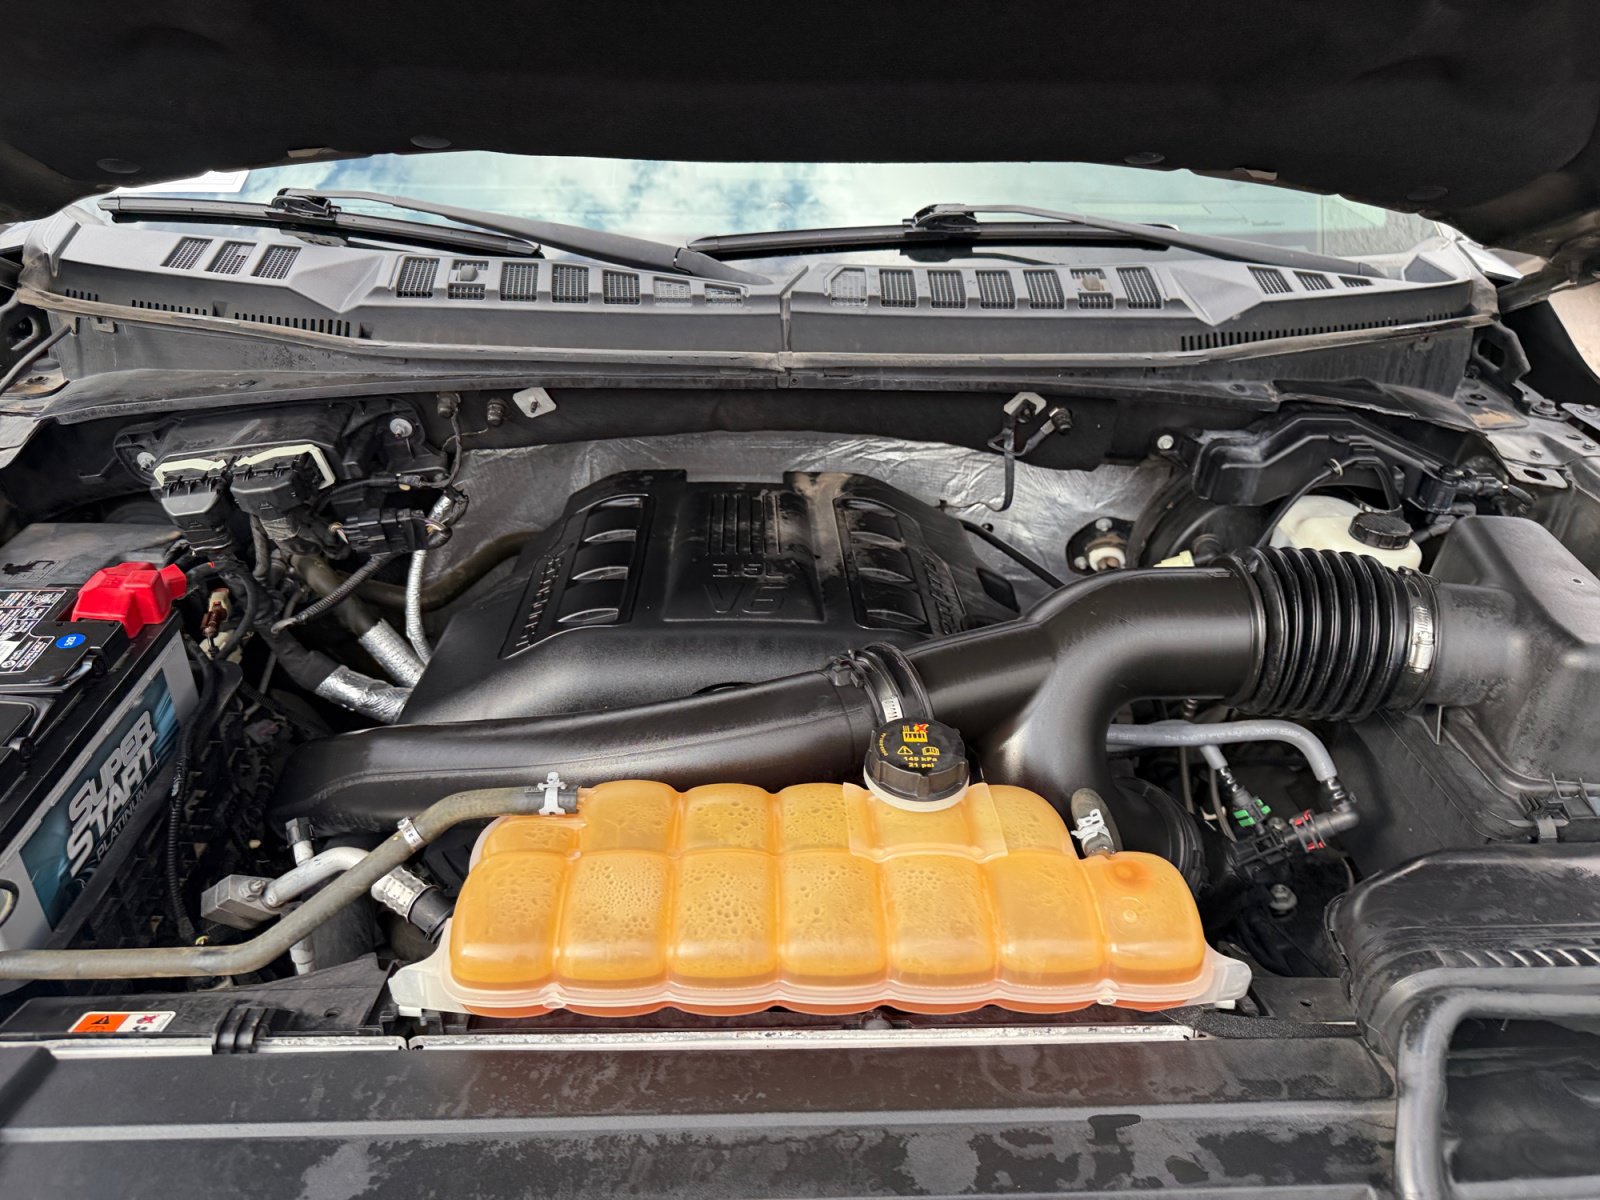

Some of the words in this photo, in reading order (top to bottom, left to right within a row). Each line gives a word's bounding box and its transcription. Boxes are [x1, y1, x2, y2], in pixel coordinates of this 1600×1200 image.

[703, 583, 788, 614] V6
[712, 563, 784, 578] 3.5L
[67, 731, 159, 878] START
[69, 710, 154, 835] SUPER
[96, 784, 150, 861] PLATINUM
